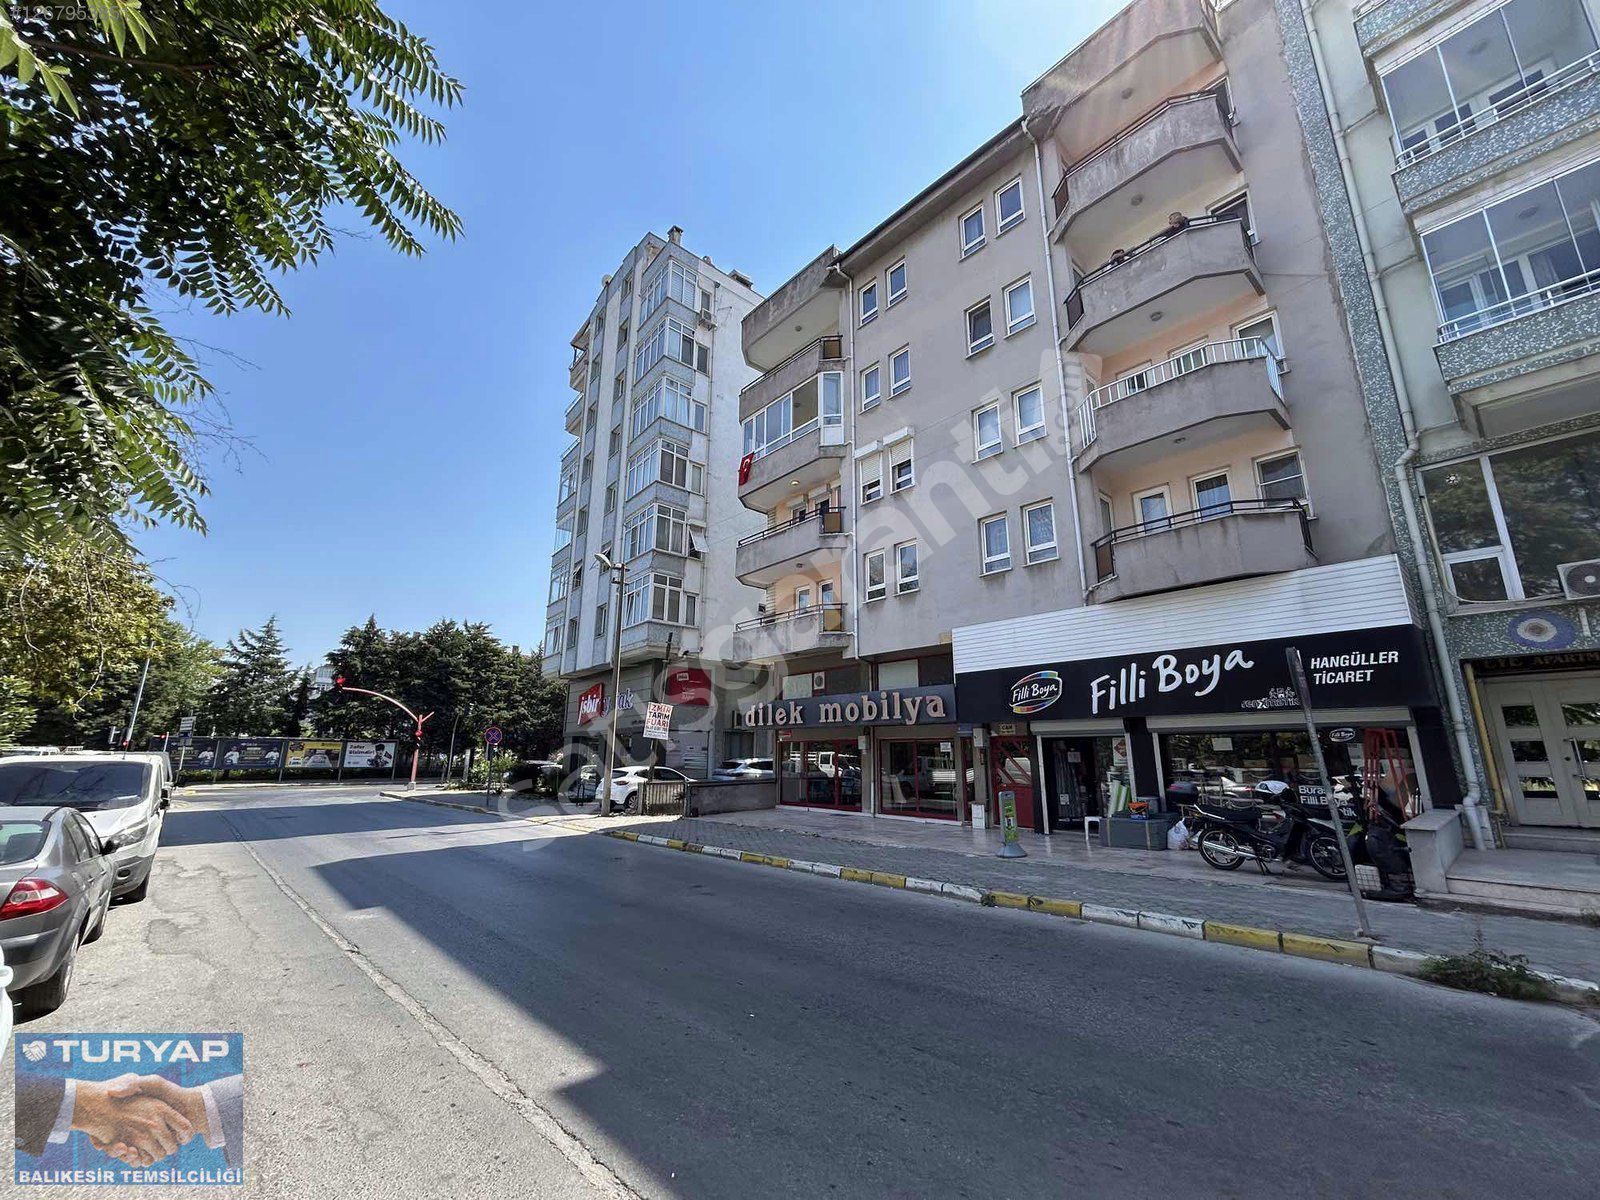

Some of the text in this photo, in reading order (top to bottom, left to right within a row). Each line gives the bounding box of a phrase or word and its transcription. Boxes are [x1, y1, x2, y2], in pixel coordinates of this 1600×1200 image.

[1310, 651, 1399, 670] HANGÜLLER
[1090, 649, 1255, 715] Filli Boya
[1313, 668, 1375, 685] TİCARET
[1012, 684, 1058, 702] Filli Boya
[648, 711, 670, 720] TARIM
[744, 691, 946, 728] dilek mobilya
[1320, 797, 1348, 807] Bya
